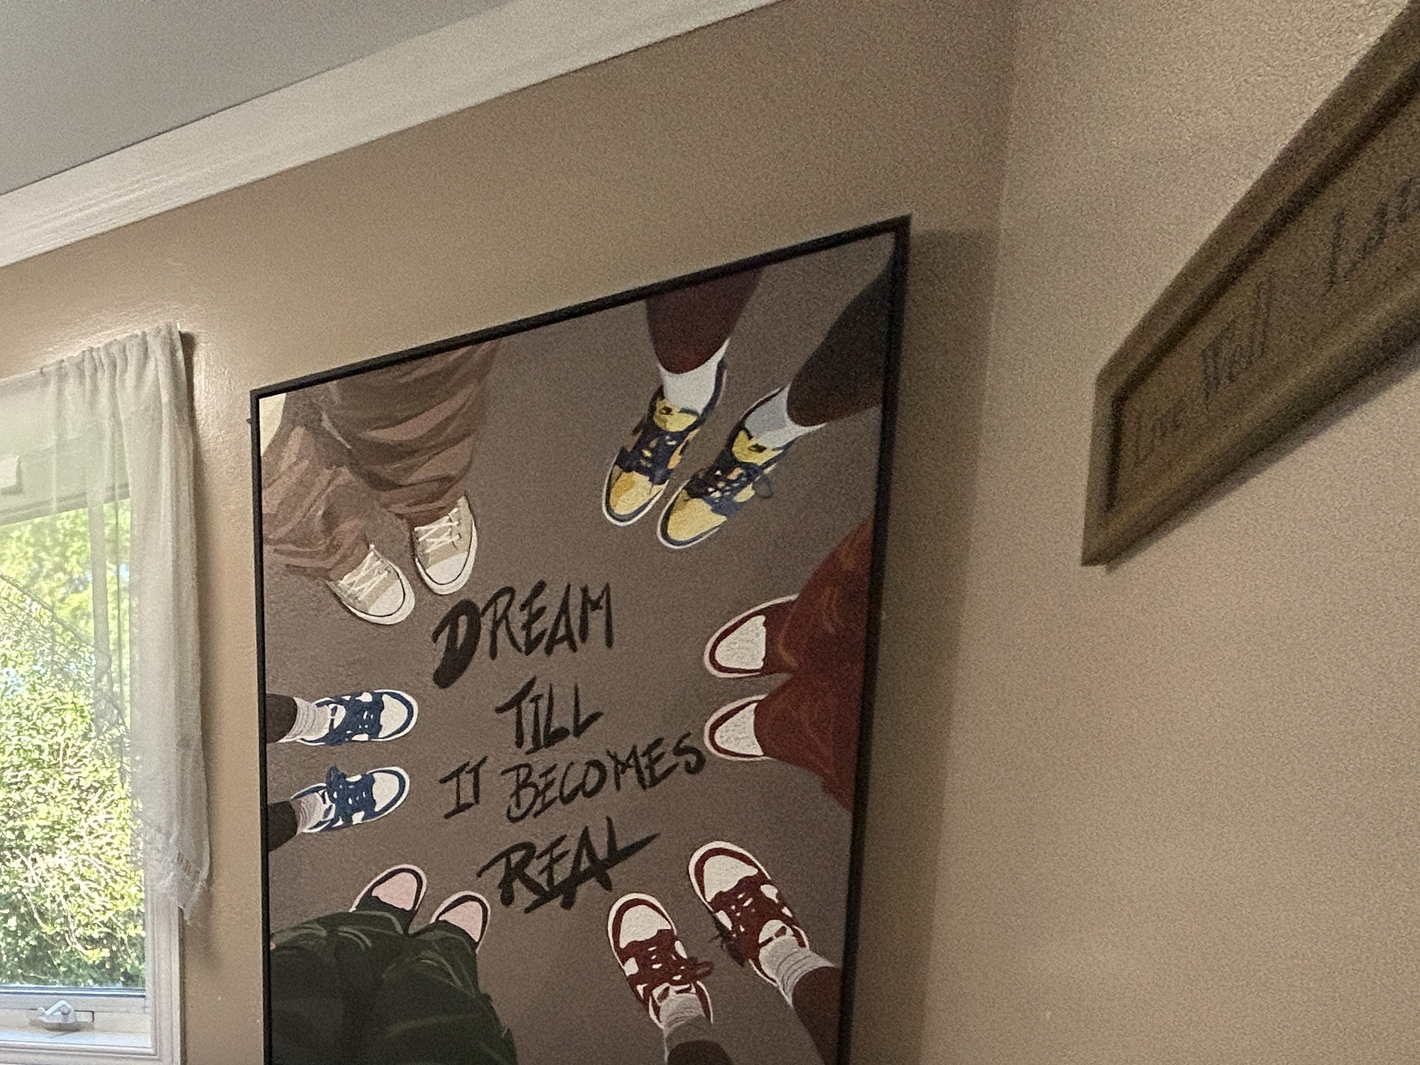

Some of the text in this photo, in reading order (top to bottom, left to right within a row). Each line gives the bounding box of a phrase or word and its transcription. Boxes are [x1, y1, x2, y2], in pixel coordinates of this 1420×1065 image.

[432, 579, 614, 689] DREAM
[495, 675, 604, 756] TILL
[439, 732, 707, 824] IT BECOMES
[476, 815, 661, 914] REAL
